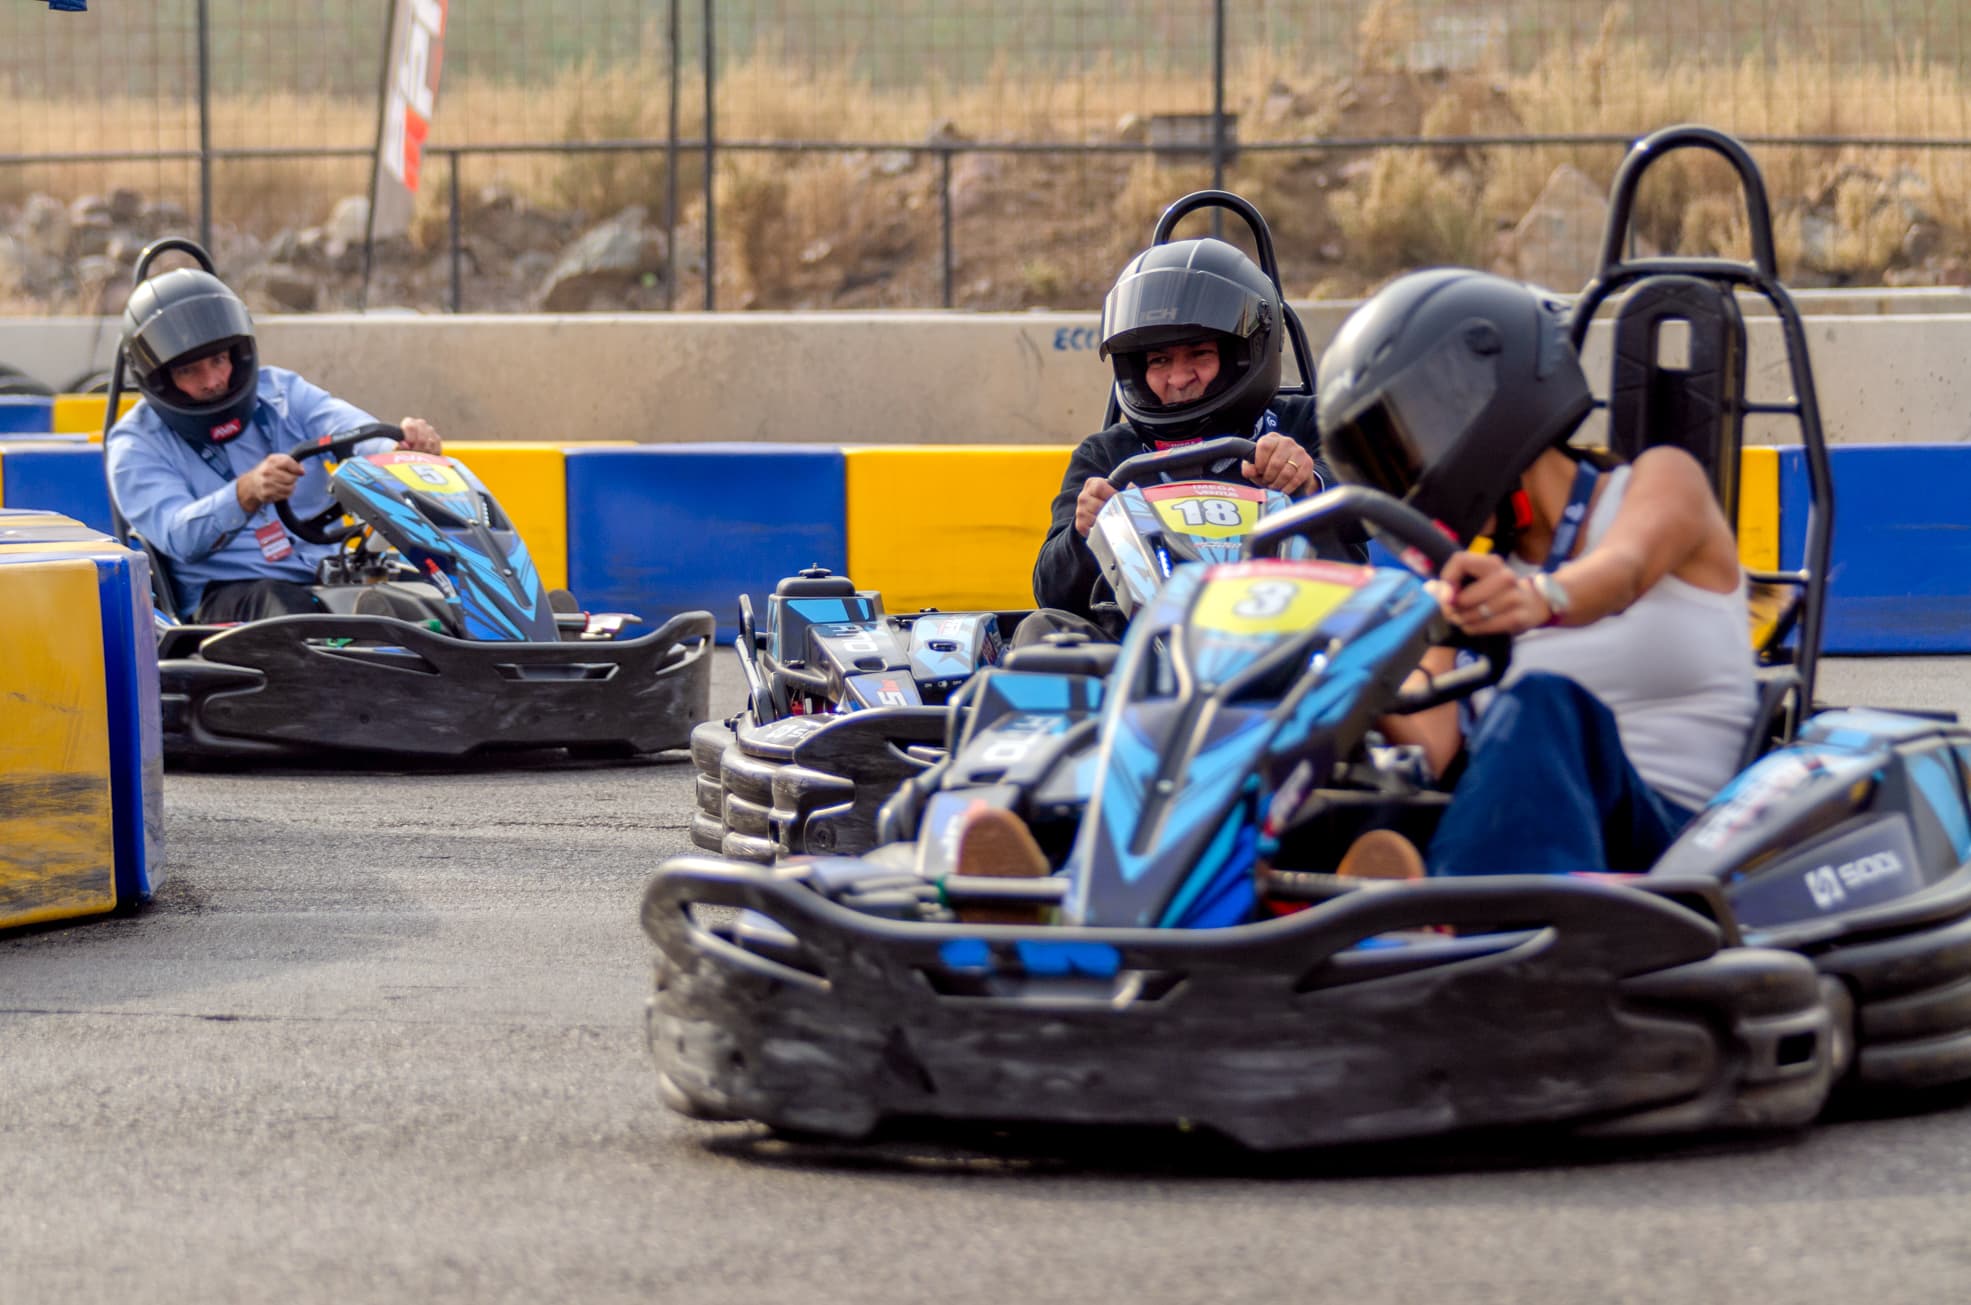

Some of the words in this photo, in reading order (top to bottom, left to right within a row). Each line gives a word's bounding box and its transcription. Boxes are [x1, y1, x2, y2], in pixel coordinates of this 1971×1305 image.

[408, 463, 449, 485] 5
[1171, 499, 1242, 526] 18
[1232, 579, 1299, 619] 3
